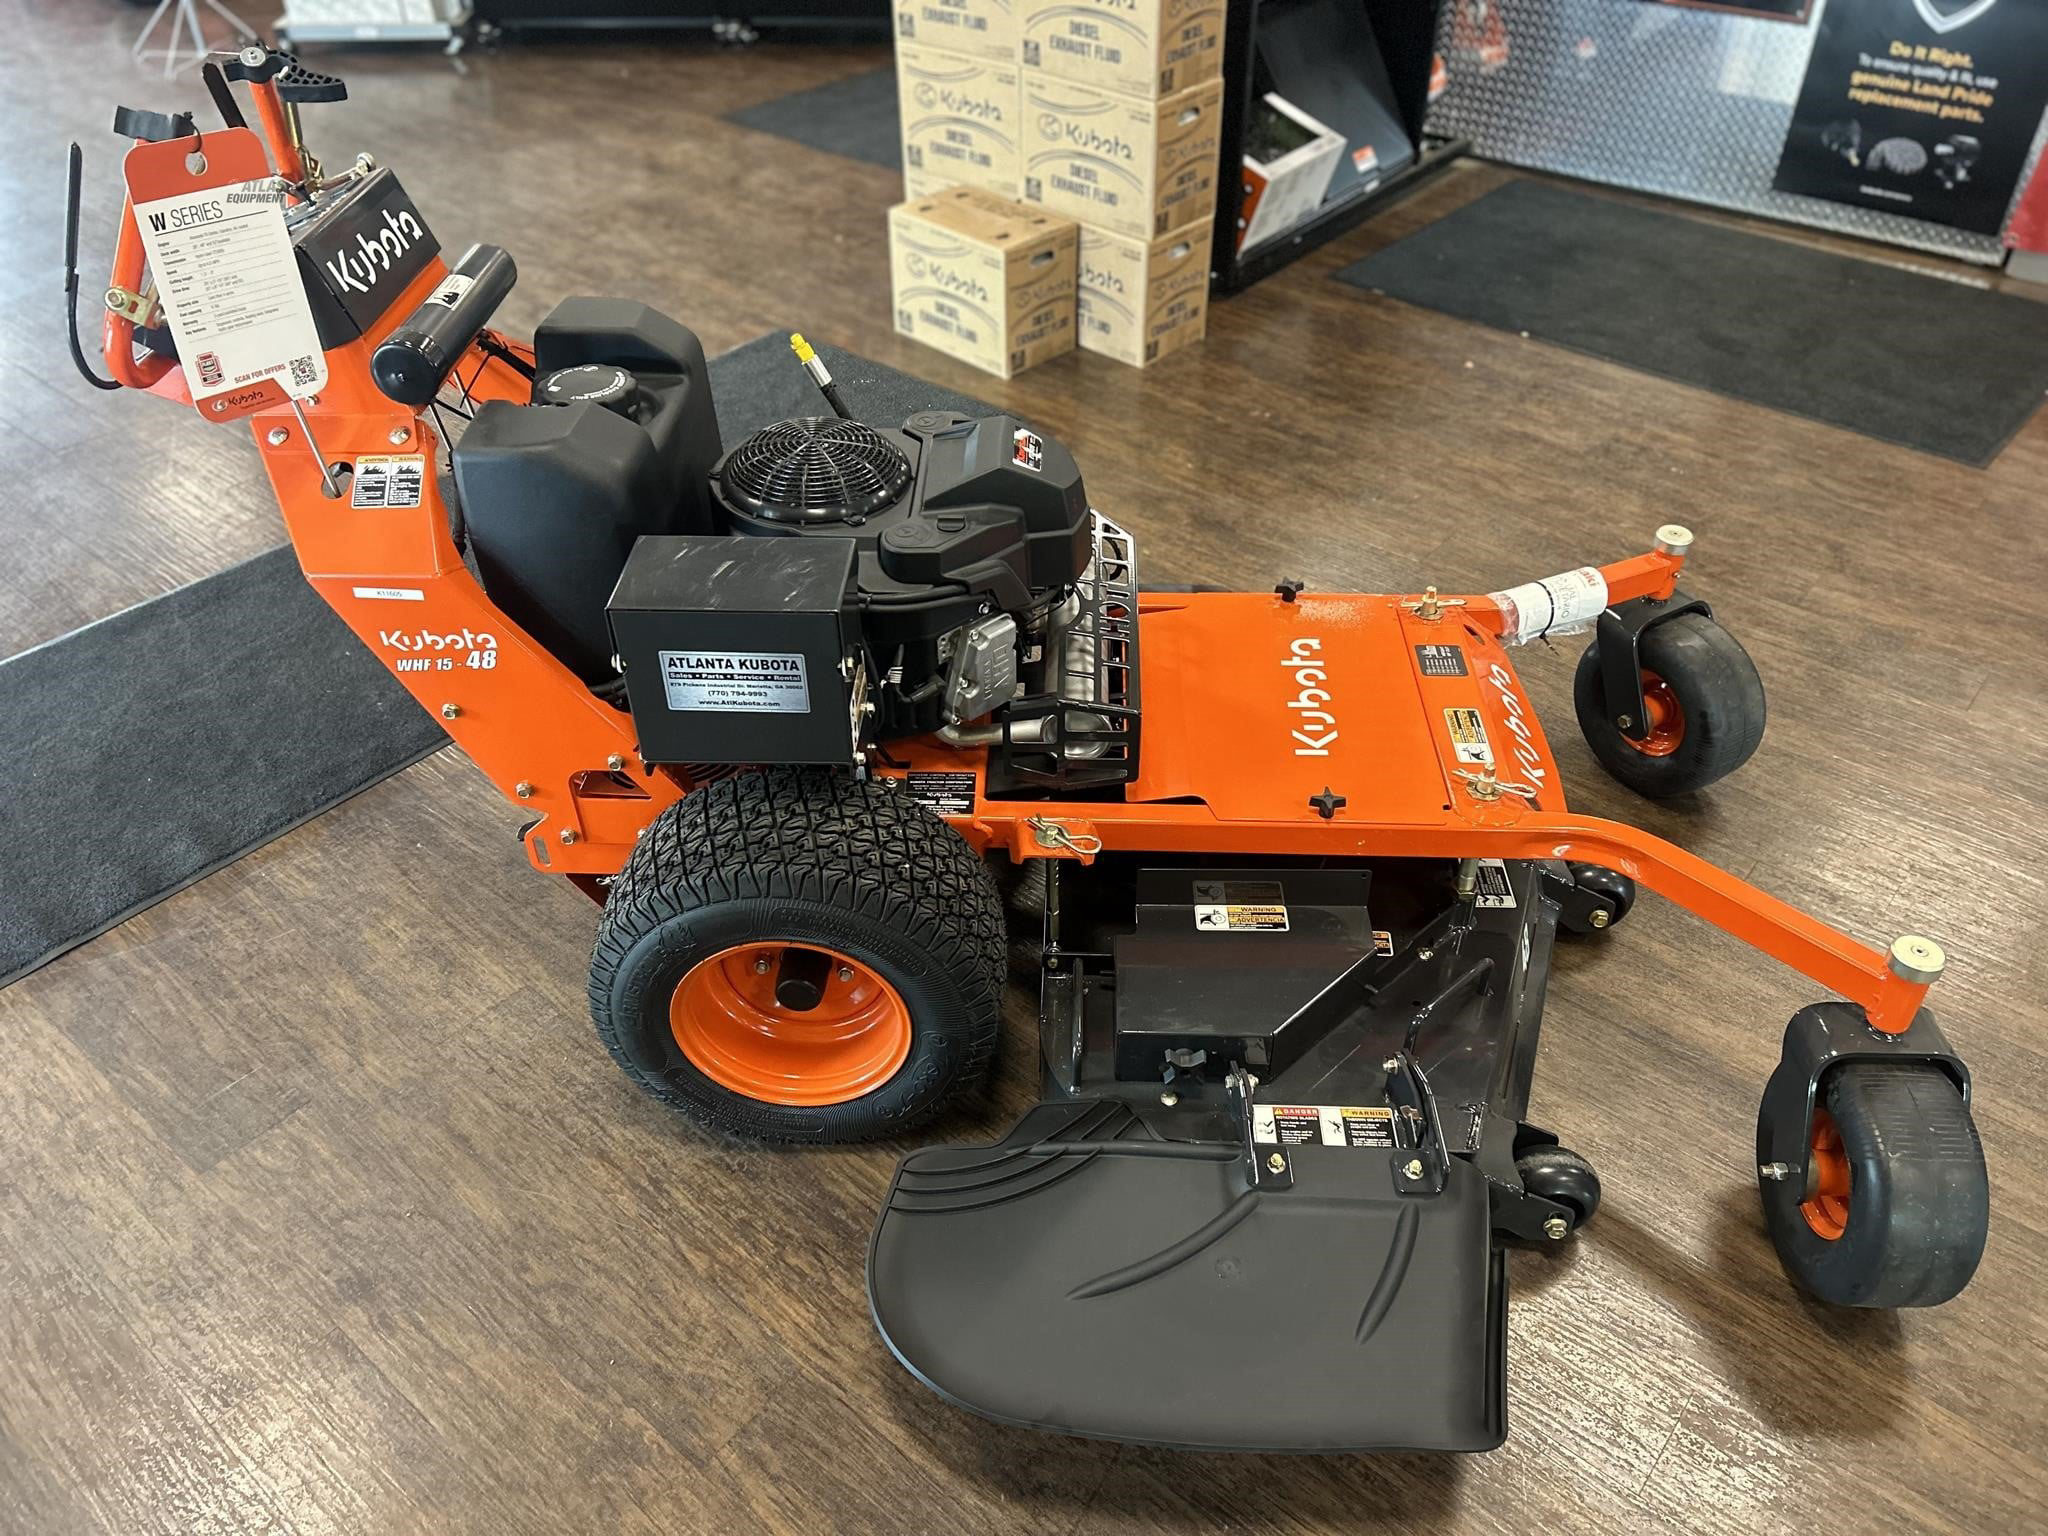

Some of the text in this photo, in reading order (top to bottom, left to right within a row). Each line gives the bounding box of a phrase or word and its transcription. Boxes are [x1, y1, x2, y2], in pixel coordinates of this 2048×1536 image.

[1069, 20, 1100, 40] DIESEL
[1049, 34, 1121, 64] EXHAUST FLUID
[1889, 40, 1913, 58] Do
[1928, 47, 1974, 69] Right.
[1858, 52, 1872, 67] To
[1873, 57, 1911, 73] ensure
[1911, 64, 1947, 82] quality
[1975, 76, 1999, 89] use
[1851, 71, 1994, 107] genuine Land Pride
[940, 89, 1003, 121] Kubota
[1848, 87, 1985, 124] replacement parts.
[1065, 122, 1134, 160] Kubota
[1070, 163, 1098, 184] DIESEL
[1093, 187, 1119, 207] FLUID
[148, 212, 167, 232] W
[170, 200, 223, 228] SERIES
[326, 209, 424, 293] Kubota
[928, 262, 988, 302] Kubota
[1078, 262, 1125, 293] bota
[234, 363, 287, 384] SCAN FOR OFFERS
[228, 391, 264, 406] Kubota
[378, 627, 499, 652] Kubota
[396, 658, 432, 672] WHF
[434, 657, 453, 671] 15
[465, 650, 497, 670] 48
[668, 657, 800, 671] ATLANTA KUBOTA
[1280, 637, 1339, 756] Kubota
[1488, 663, 1546, 789] Kubota
